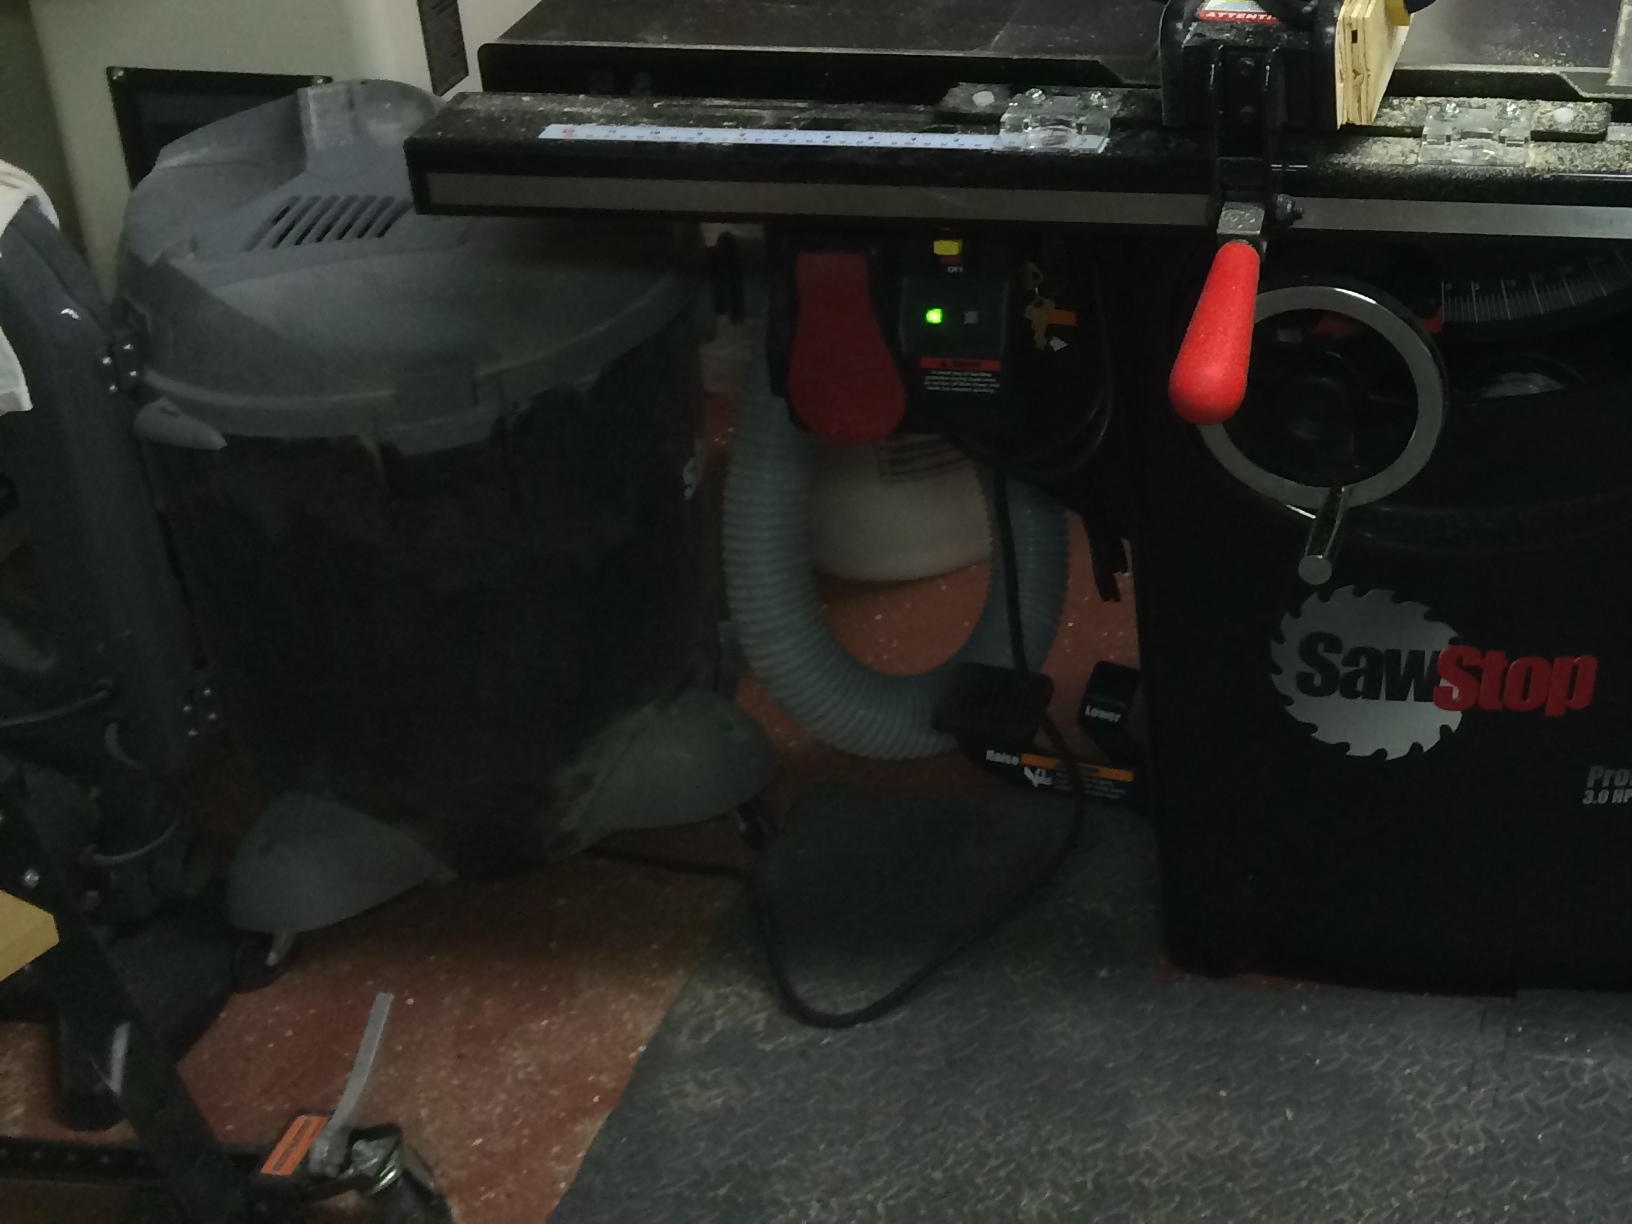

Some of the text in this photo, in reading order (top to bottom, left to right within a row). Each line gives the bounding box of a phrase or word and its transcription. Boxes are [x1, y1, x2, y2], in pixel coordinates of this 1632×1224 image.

[1205, 11, 1277, 21] ATTENTI
[1295, 630, 1599, 718] SawStop
[1582, 789, 1610, 805] 3.0
